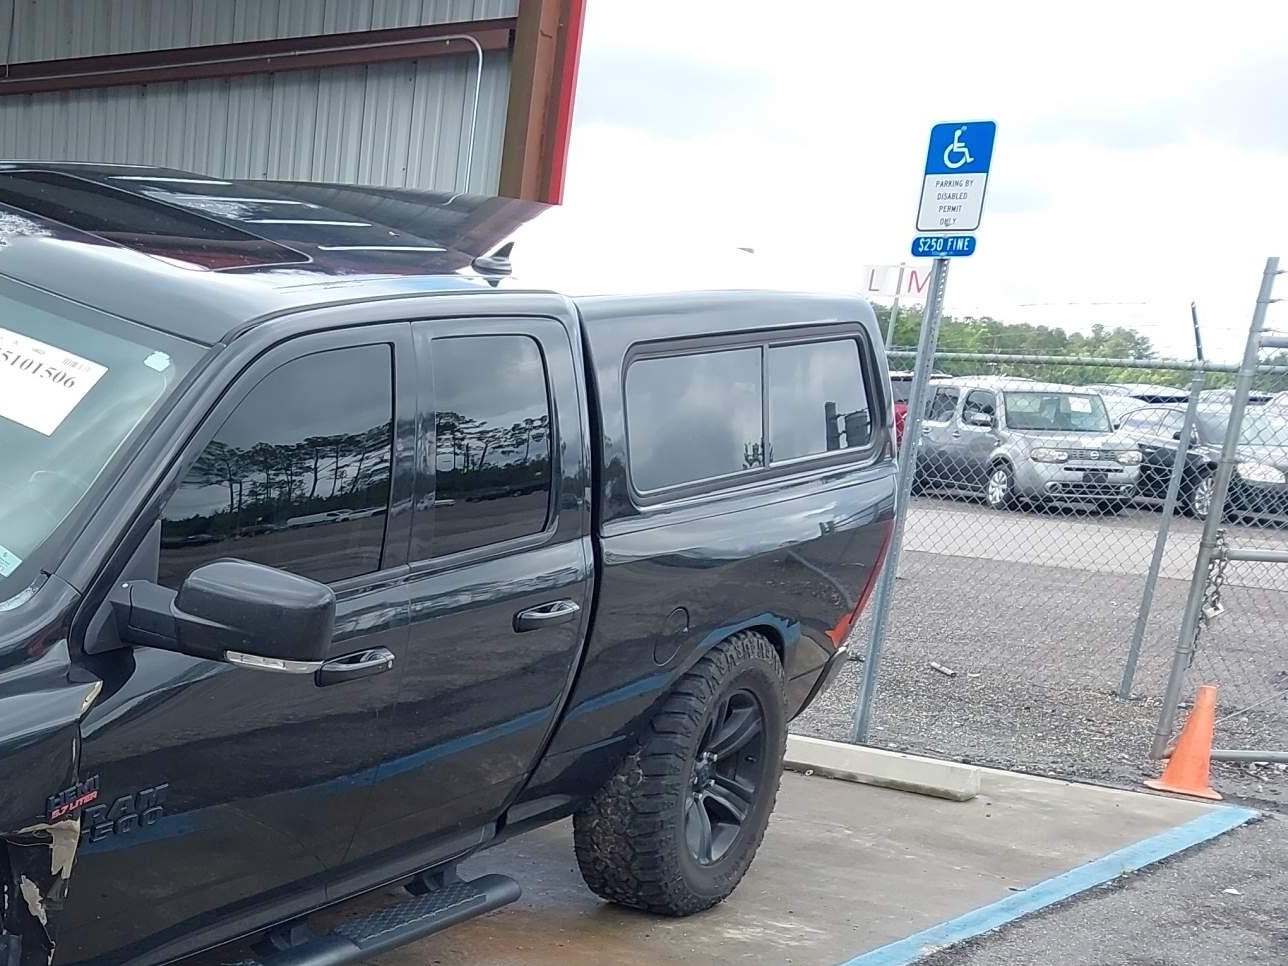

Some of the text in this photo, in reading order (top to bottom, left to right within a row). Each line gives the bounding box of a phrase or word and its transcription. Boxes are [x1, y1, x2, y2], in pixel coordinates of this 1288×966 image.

[935, 180, 964, 188] PARKING
[937, 192, 968, 200] DISABLED
[938, 205, 962, 213] PERMIT
[918, 237, 970, 252] $250 FINE
[81, 783, 169, 822] RAM
